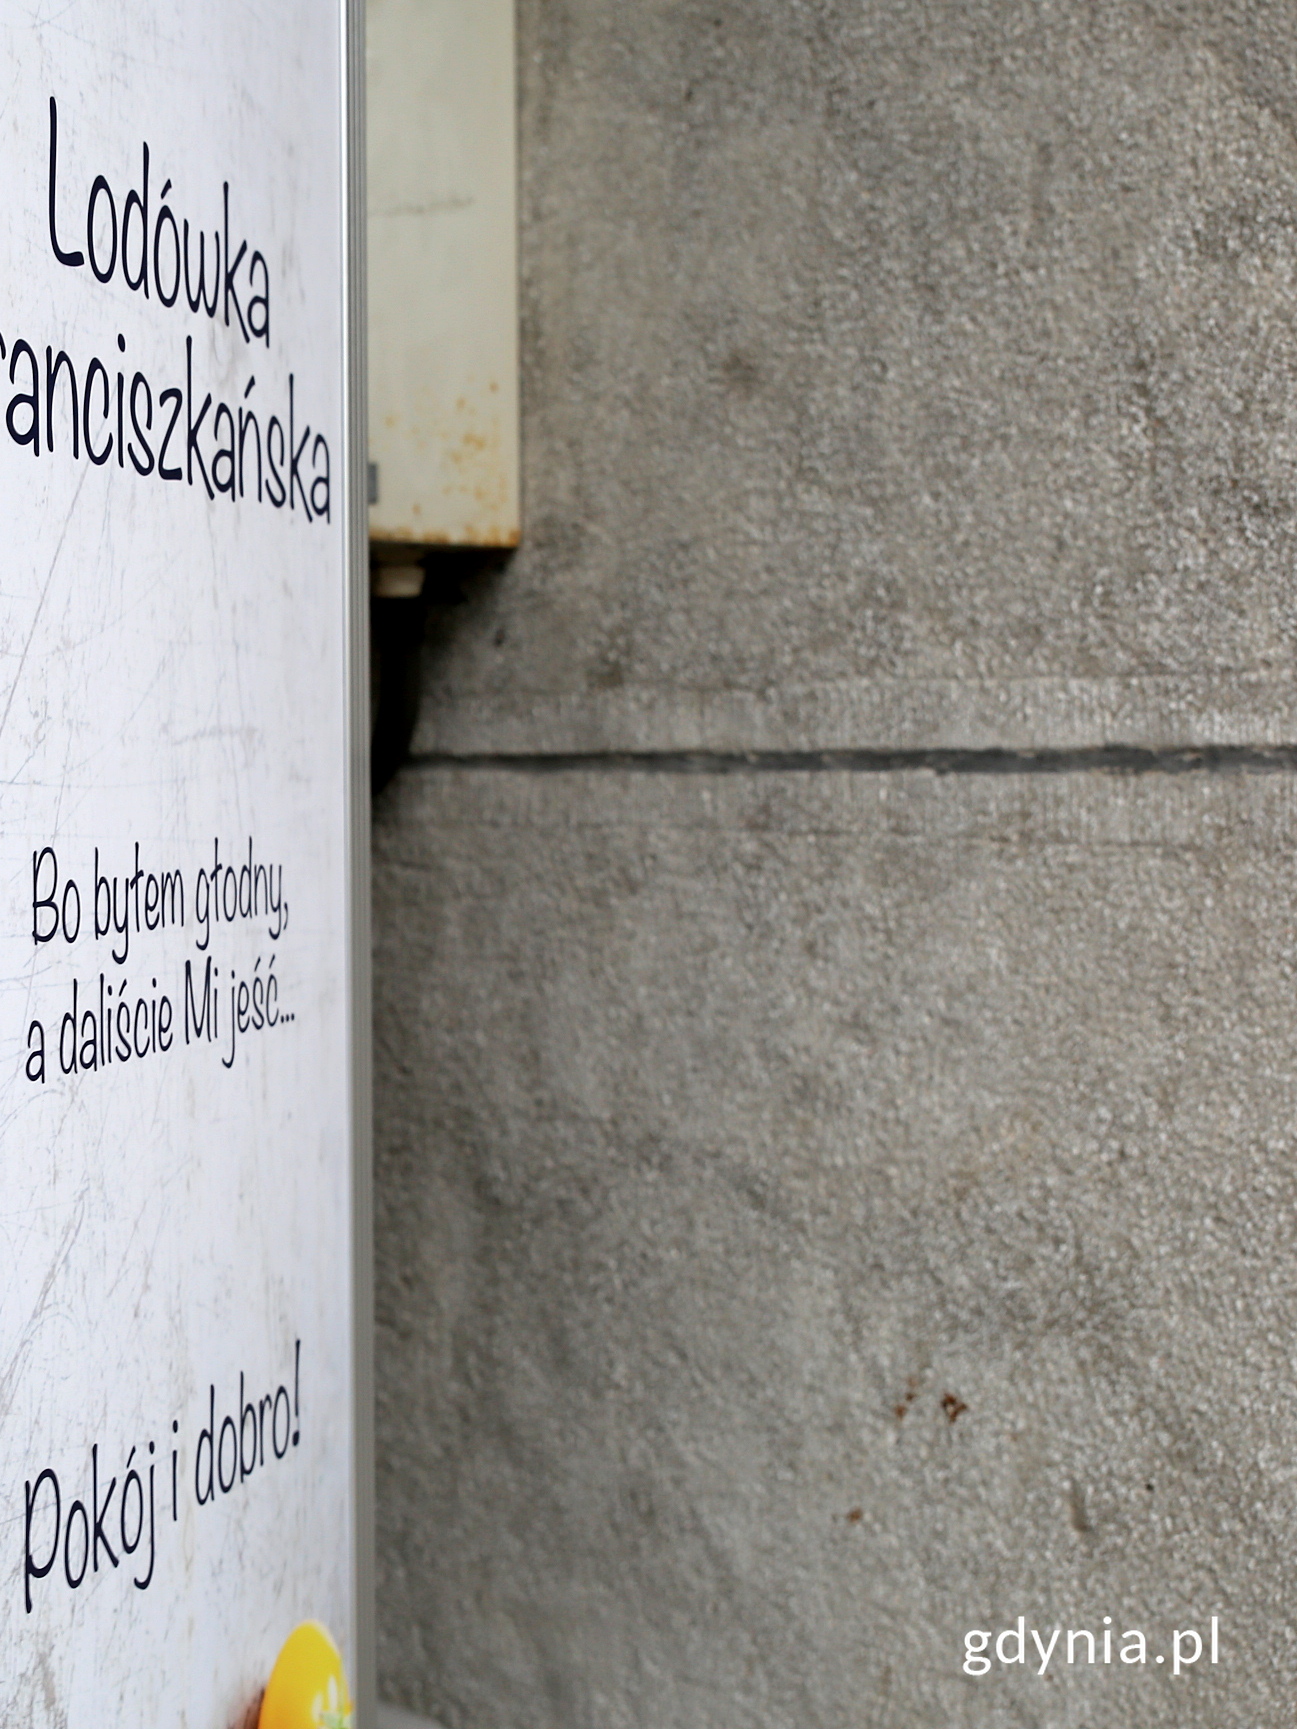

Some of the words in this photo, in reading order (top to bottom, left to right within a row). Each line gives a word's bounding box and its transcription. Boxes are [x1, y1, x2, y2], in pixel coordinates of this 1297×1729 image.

[48, 96, 270, 349] Lodówka
[31, 846, 81, 946] Bo
[94, 841, 184, 965] byłem
[195, 836, 289, 951] głodny,
[25, 1019, 46, 1084] a
[59, 972, 174, 1075] daliście
[184, 955, 219, 1045] Mi
[24, 1440, 155, 1615] Pokój
[172, 1419, 179, 1522] i
[194, 1338, 301, 1506] dobro!
